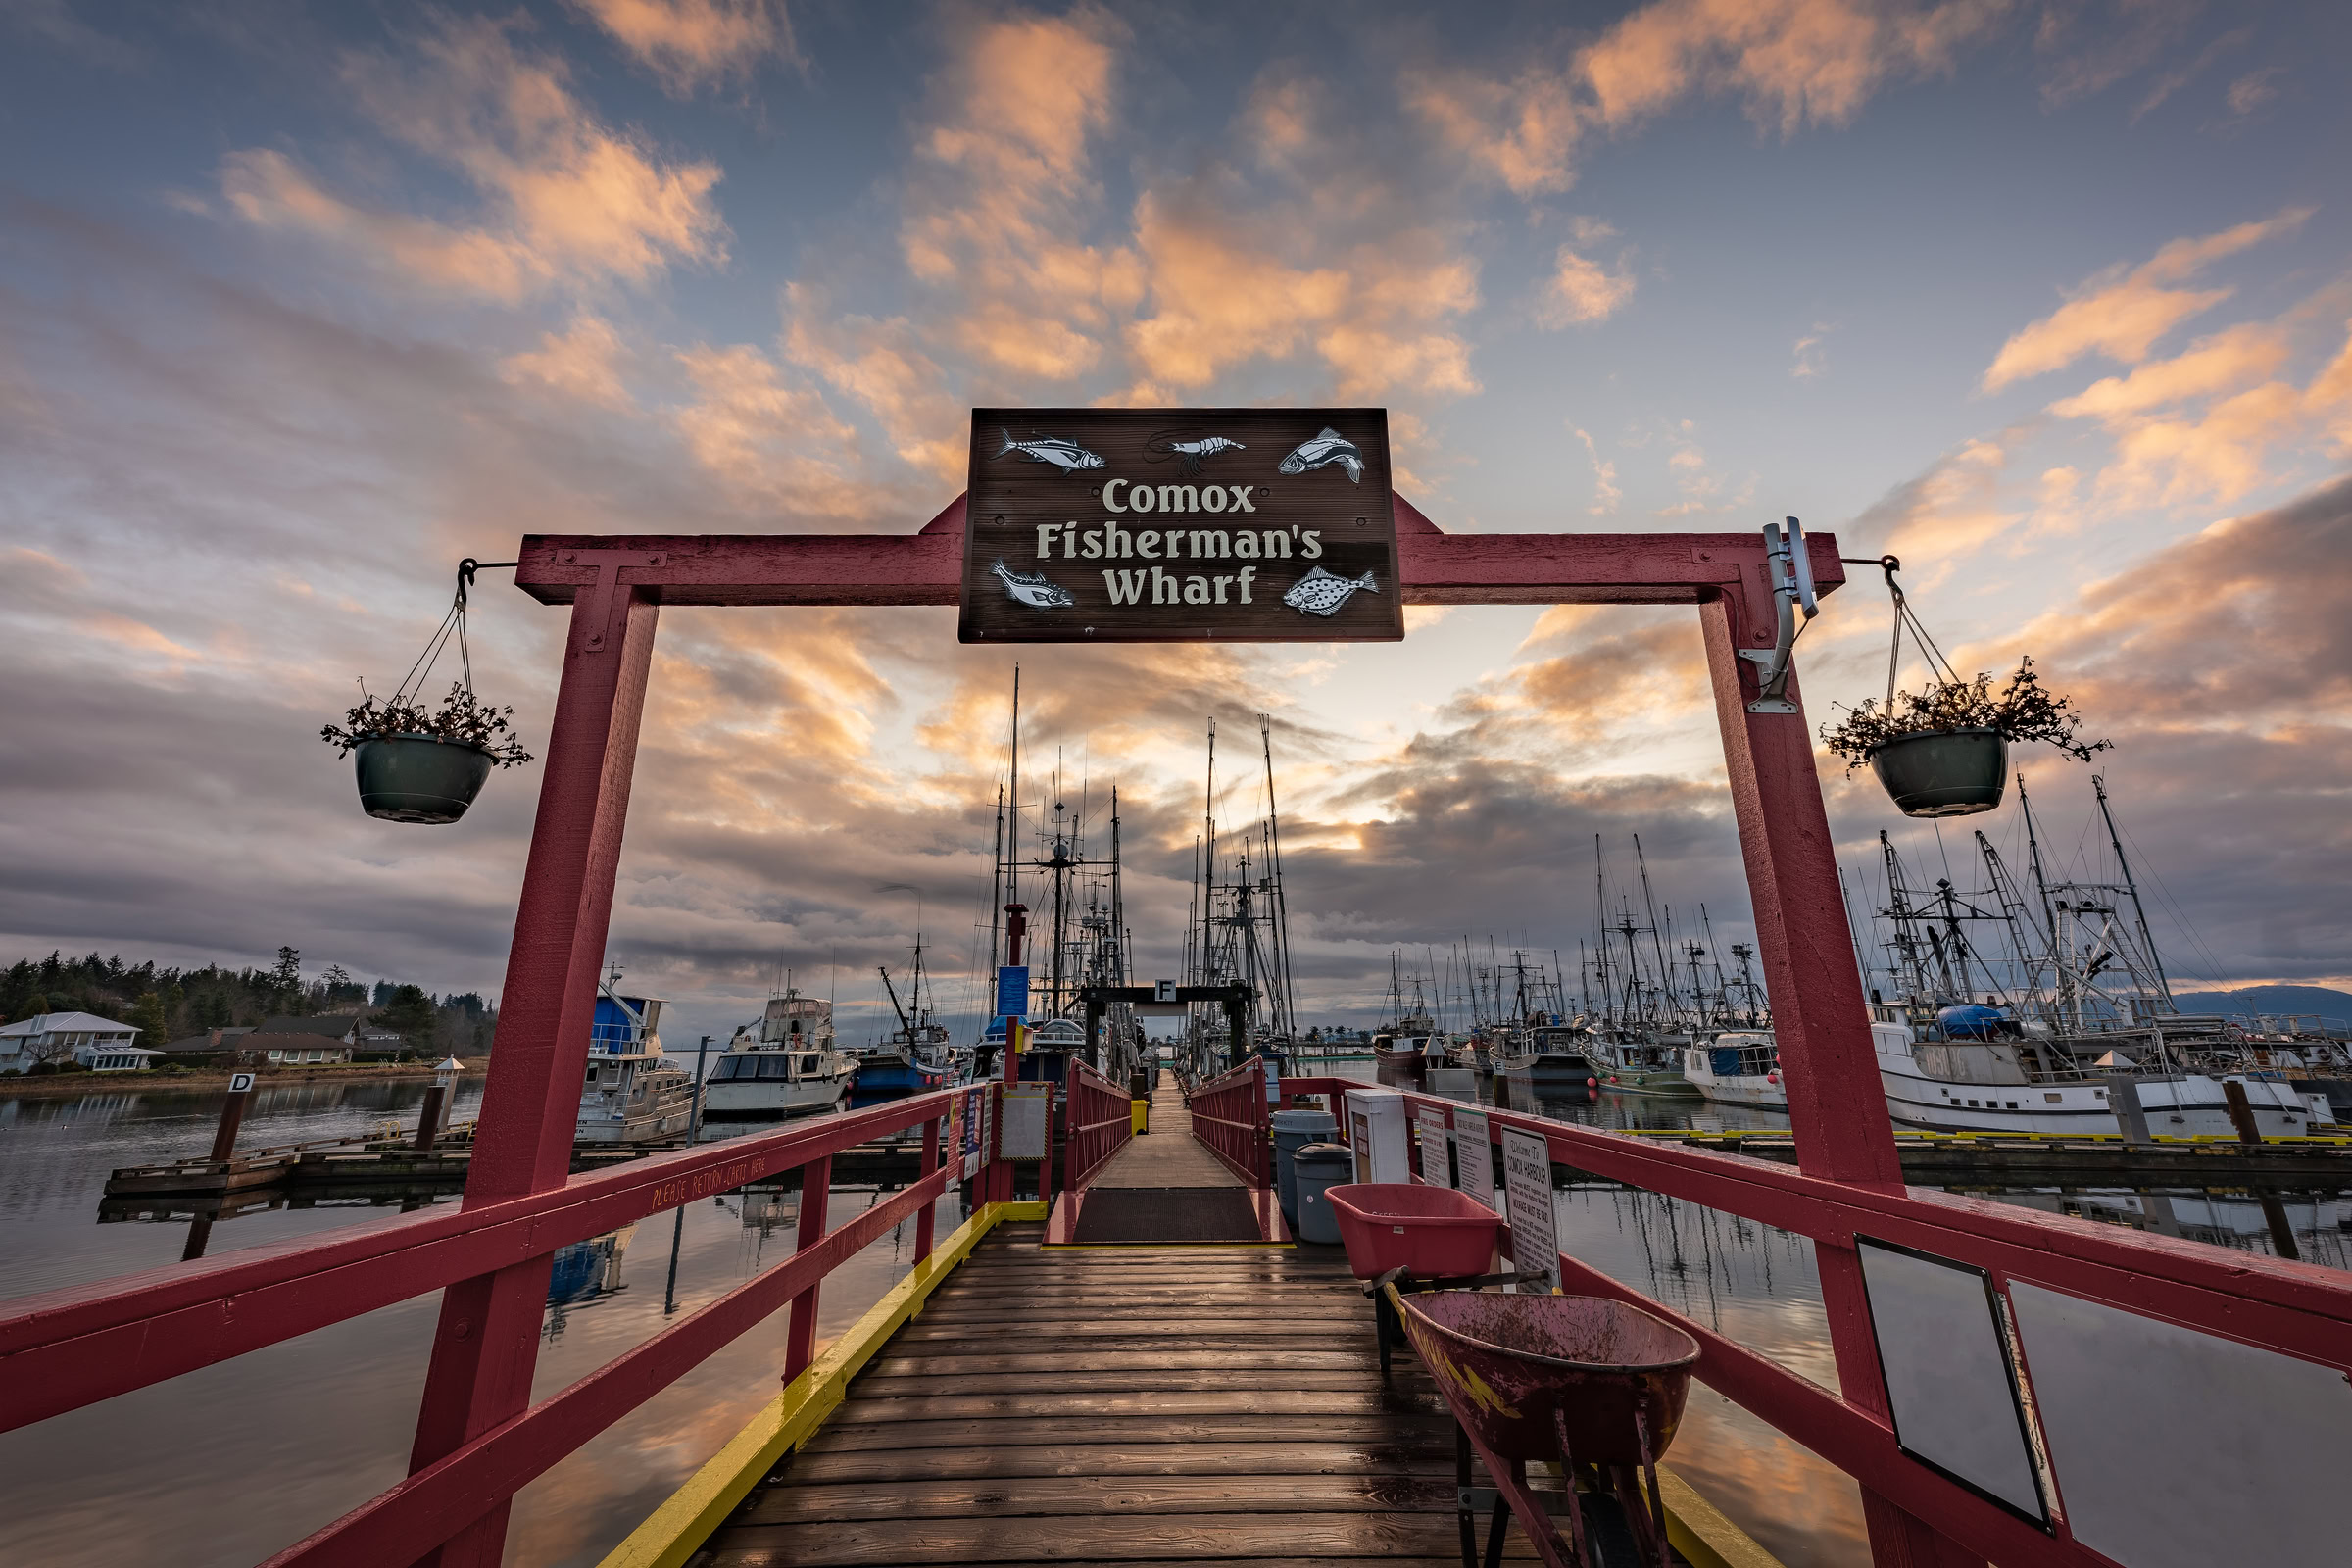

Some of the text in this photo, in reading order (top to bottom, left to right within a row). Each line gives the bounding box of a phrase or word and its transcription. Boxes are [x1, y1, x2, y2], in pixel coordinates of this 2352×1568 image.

[1102, 478, 1256, 514] Comox
[1036, 520, 1323, 559] Fisherman's
[1102, 566, 1257, 605] Wharf
[1159, 981, 1172, 1000] F
[1494, 1061, 1502, 1070] E
[232, 1075, 250, 1090] D
[1429, 1119, 1444, 1130] ORDERS
[1510, 1140, 1539, 1160] Welcome To
[1507, 1155, 1524, 1176] COMOX
[1524, 1160, 1547, 1185] HARBOUR
[652, 1180, 686, 1209] PLEASE
[692, 1169, 722, 1196] RETURN
[751, 1158, 765, 1177] HERE
